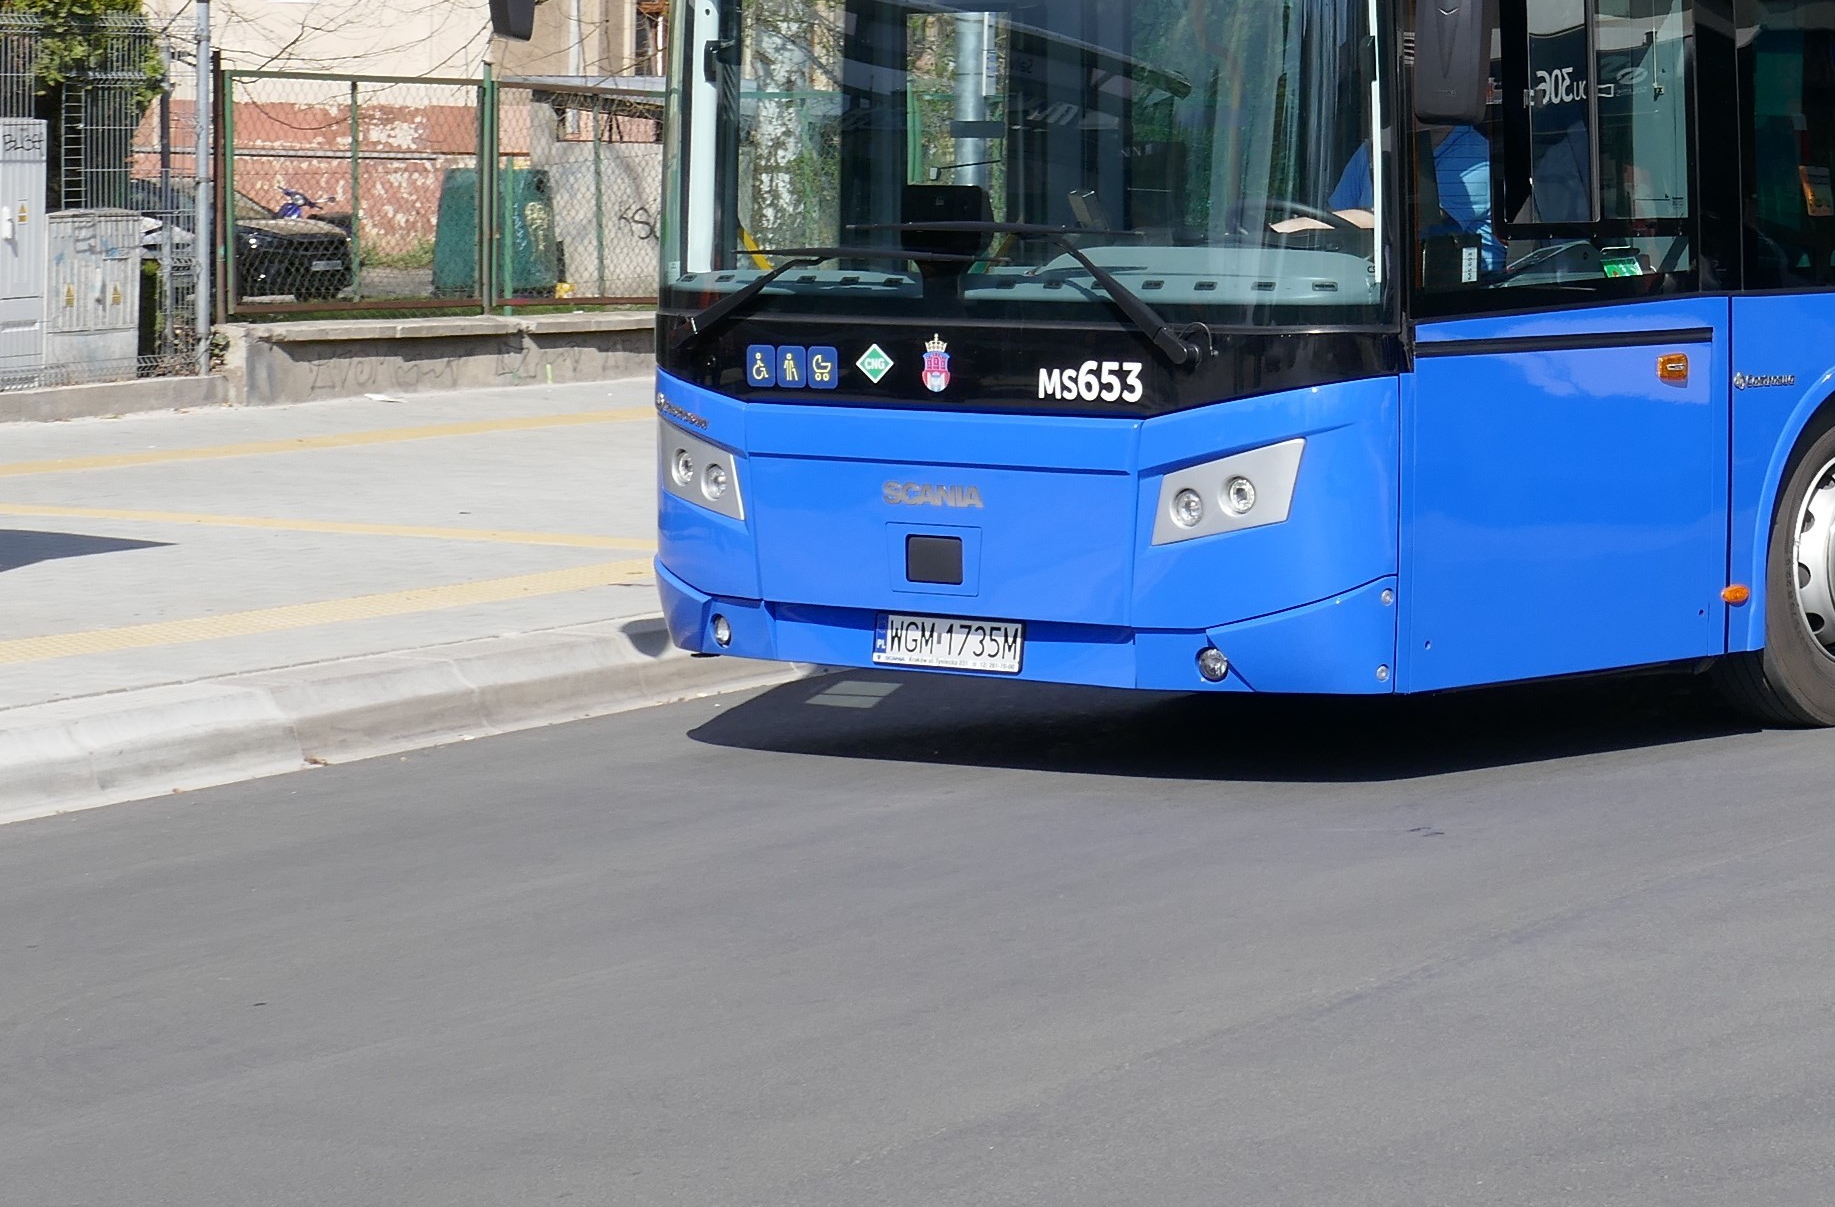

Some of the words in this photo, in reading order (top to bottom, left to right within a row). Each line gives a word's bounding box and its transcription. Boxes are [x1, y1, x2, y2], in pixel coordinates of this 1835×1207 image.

[864, 356, 886, 370] CNG
[1037, 360, 1143, 403] MS653
[882, 480, 985, 508] SCANIA
[876, 638, 886, 649] PL
[890, 619, 936, 655] WGM
[945, 622, 1020, 661] 1735M
